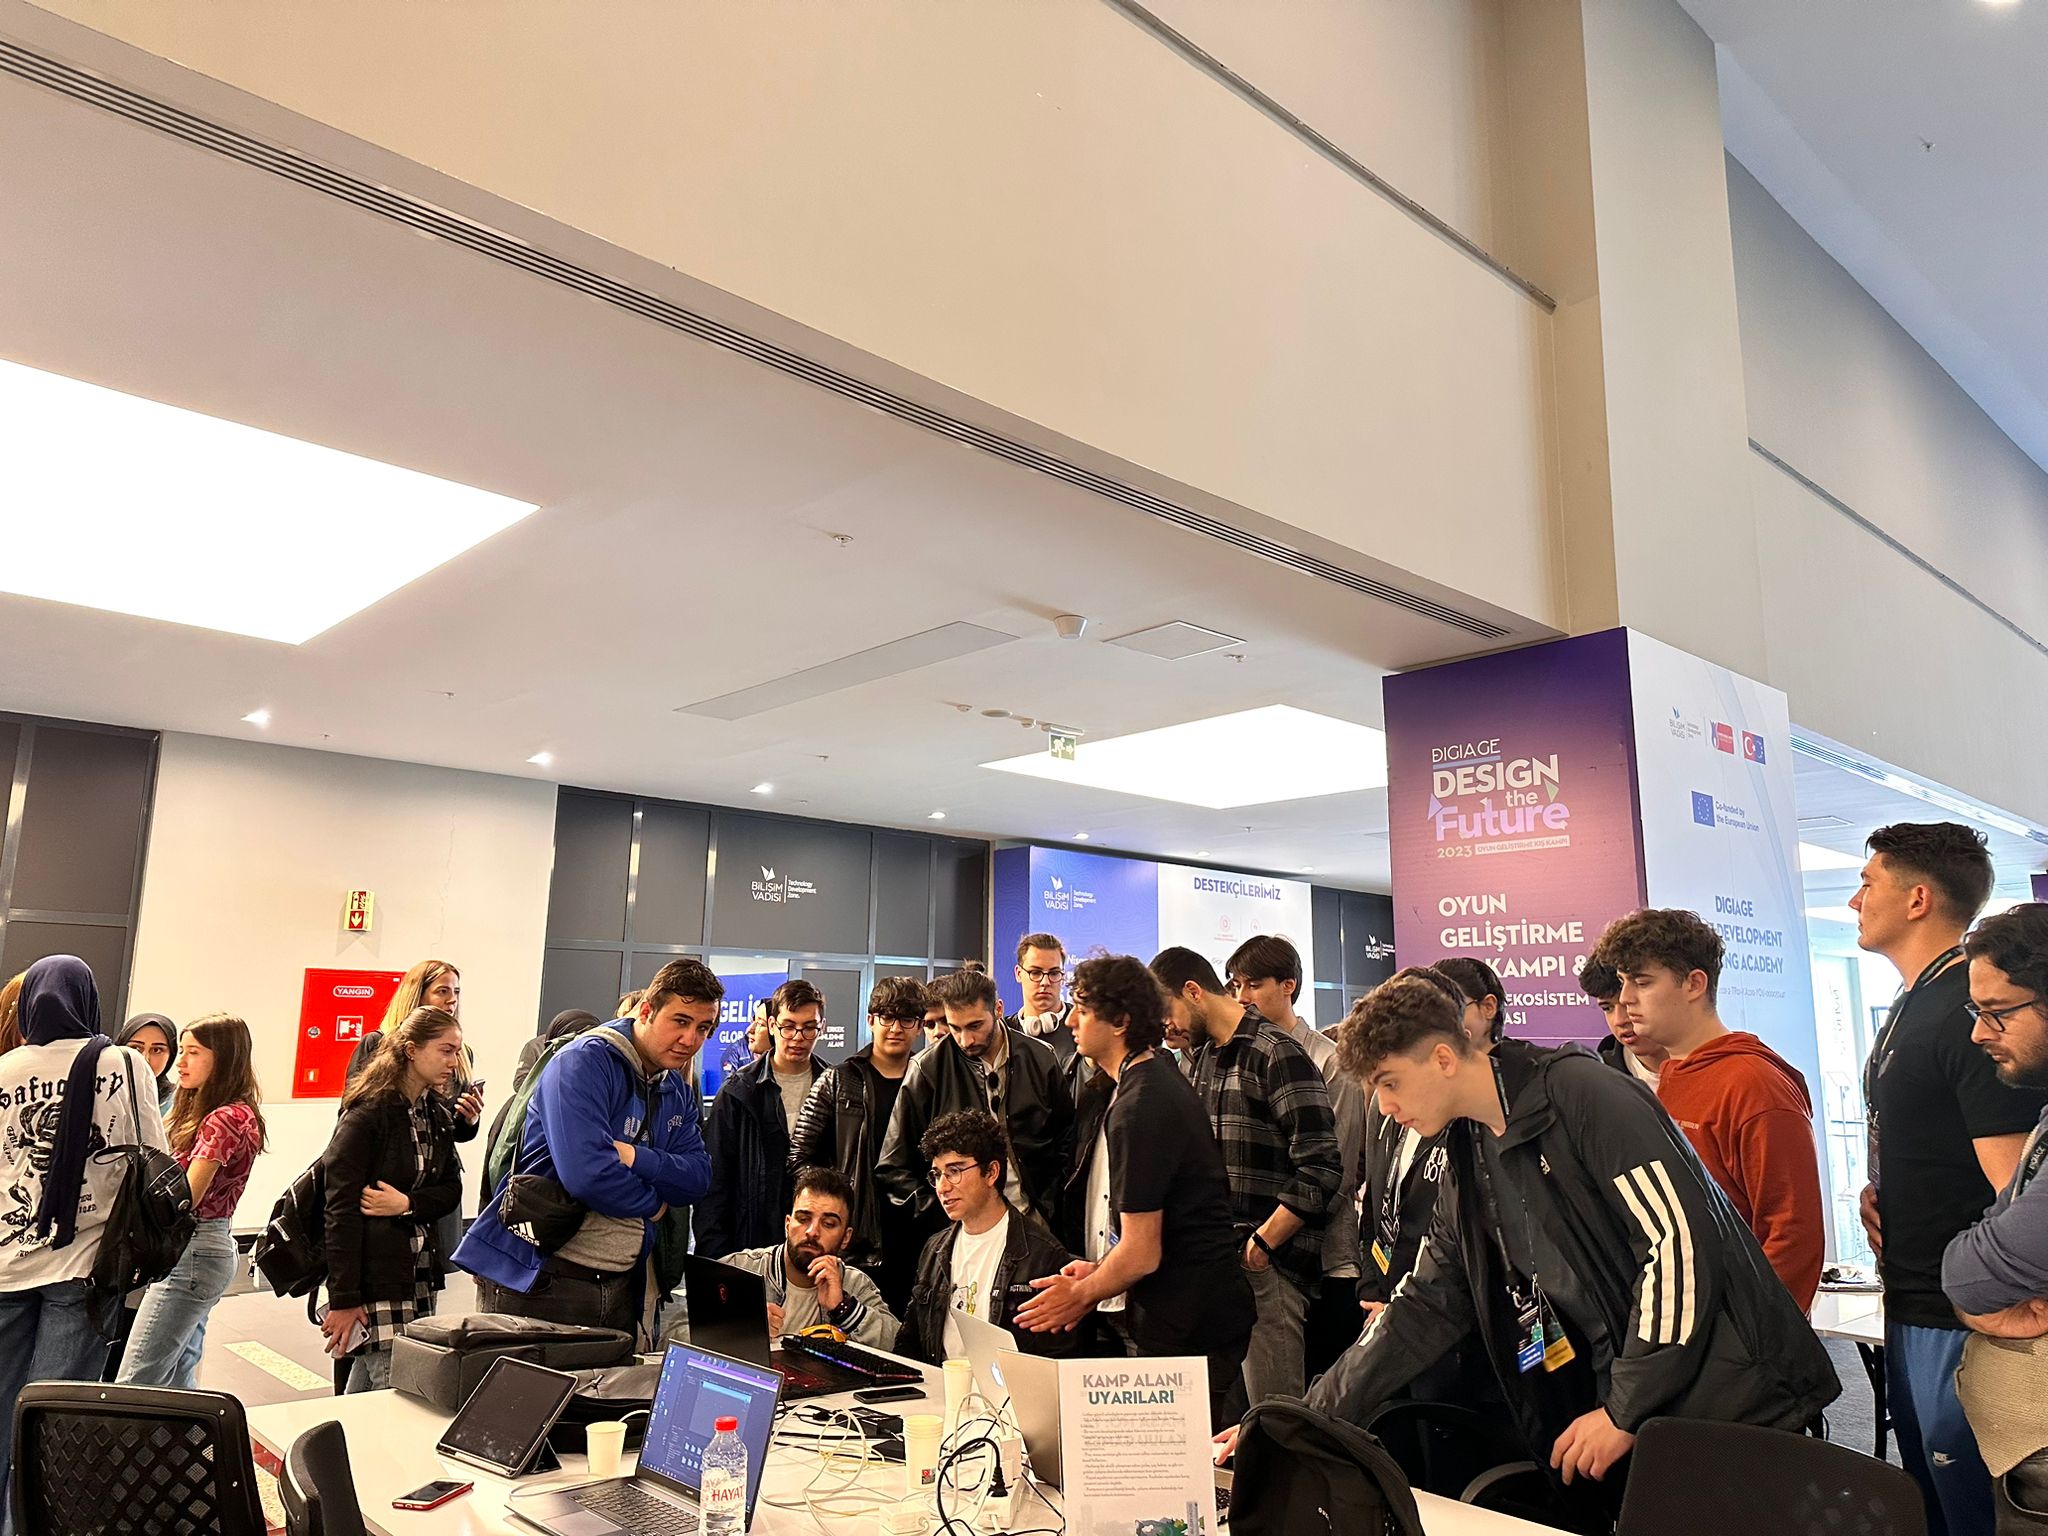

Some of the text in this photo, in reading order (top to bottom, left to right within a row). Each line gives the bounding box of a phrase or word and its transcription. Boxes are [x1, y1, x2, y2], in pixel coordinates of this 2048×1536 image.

[1433, 754, 1560, 799] DESIGN
[1505, 790, 1538, 807] the
[1436, 799, 1570, 841] Future
[1437, 846, 1472, 859] 2023
[1194, 876, 1281, 900] DESTEKÇİLERİMİZ
[1438, 893, 1507, 917] OYUN
[1715, 895, 1754, 918] DIGIAGE
[1440, 918, 1584, 952] GELİŞTİRME
[1717, 923, 1783, 948] DEVELOPMENT
[1485, 954, 1587, 978] KAMPI &
[1741, 953, 1783, 974] ACADEMY
[336, 987, 371, 996] YANGIN
[1504, 990, 1590, 1006] EKOSİSTEM
[1083, 1372, 1183, 1388] KAMP ALANI
[1088, 1390, 1175, 1405] UYARILARI
[712, 1485, 745, 1501] HAYAT
